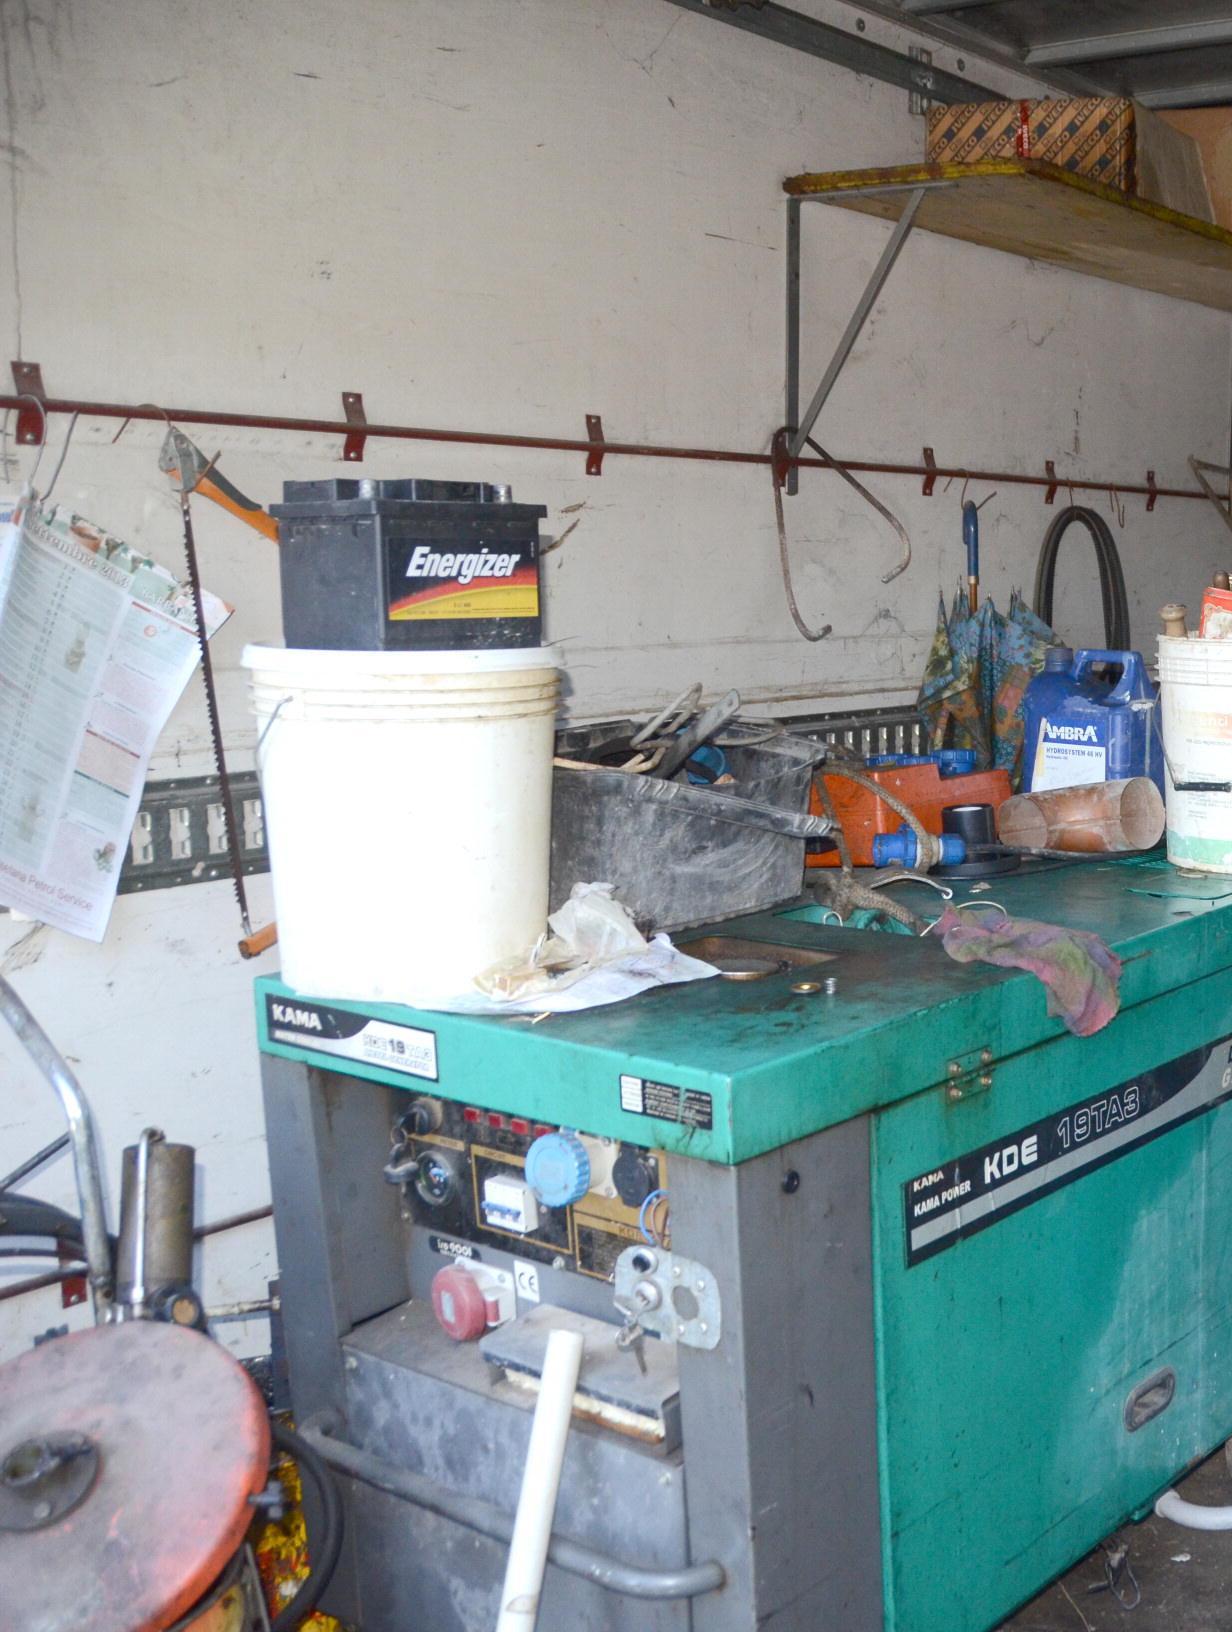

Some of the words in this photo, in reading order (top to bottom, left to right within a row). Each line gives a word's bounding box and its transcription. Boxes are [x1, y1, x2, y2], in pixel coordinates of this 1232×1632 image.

[405, 546, 521, 585] Energizer
[1044, 721, 1098, 743] AMBRA
[272, 1004, 322, 1030] KAMA
[983, 1134, 1038, 1185] KDE
[1056, 1085, 1140, 1149] 19TA3
[913, 1170, 944, 1192] KAMA
[913, 1195, 940, 1217] KAMA
[941, 1180, 972, 1205] POWER
